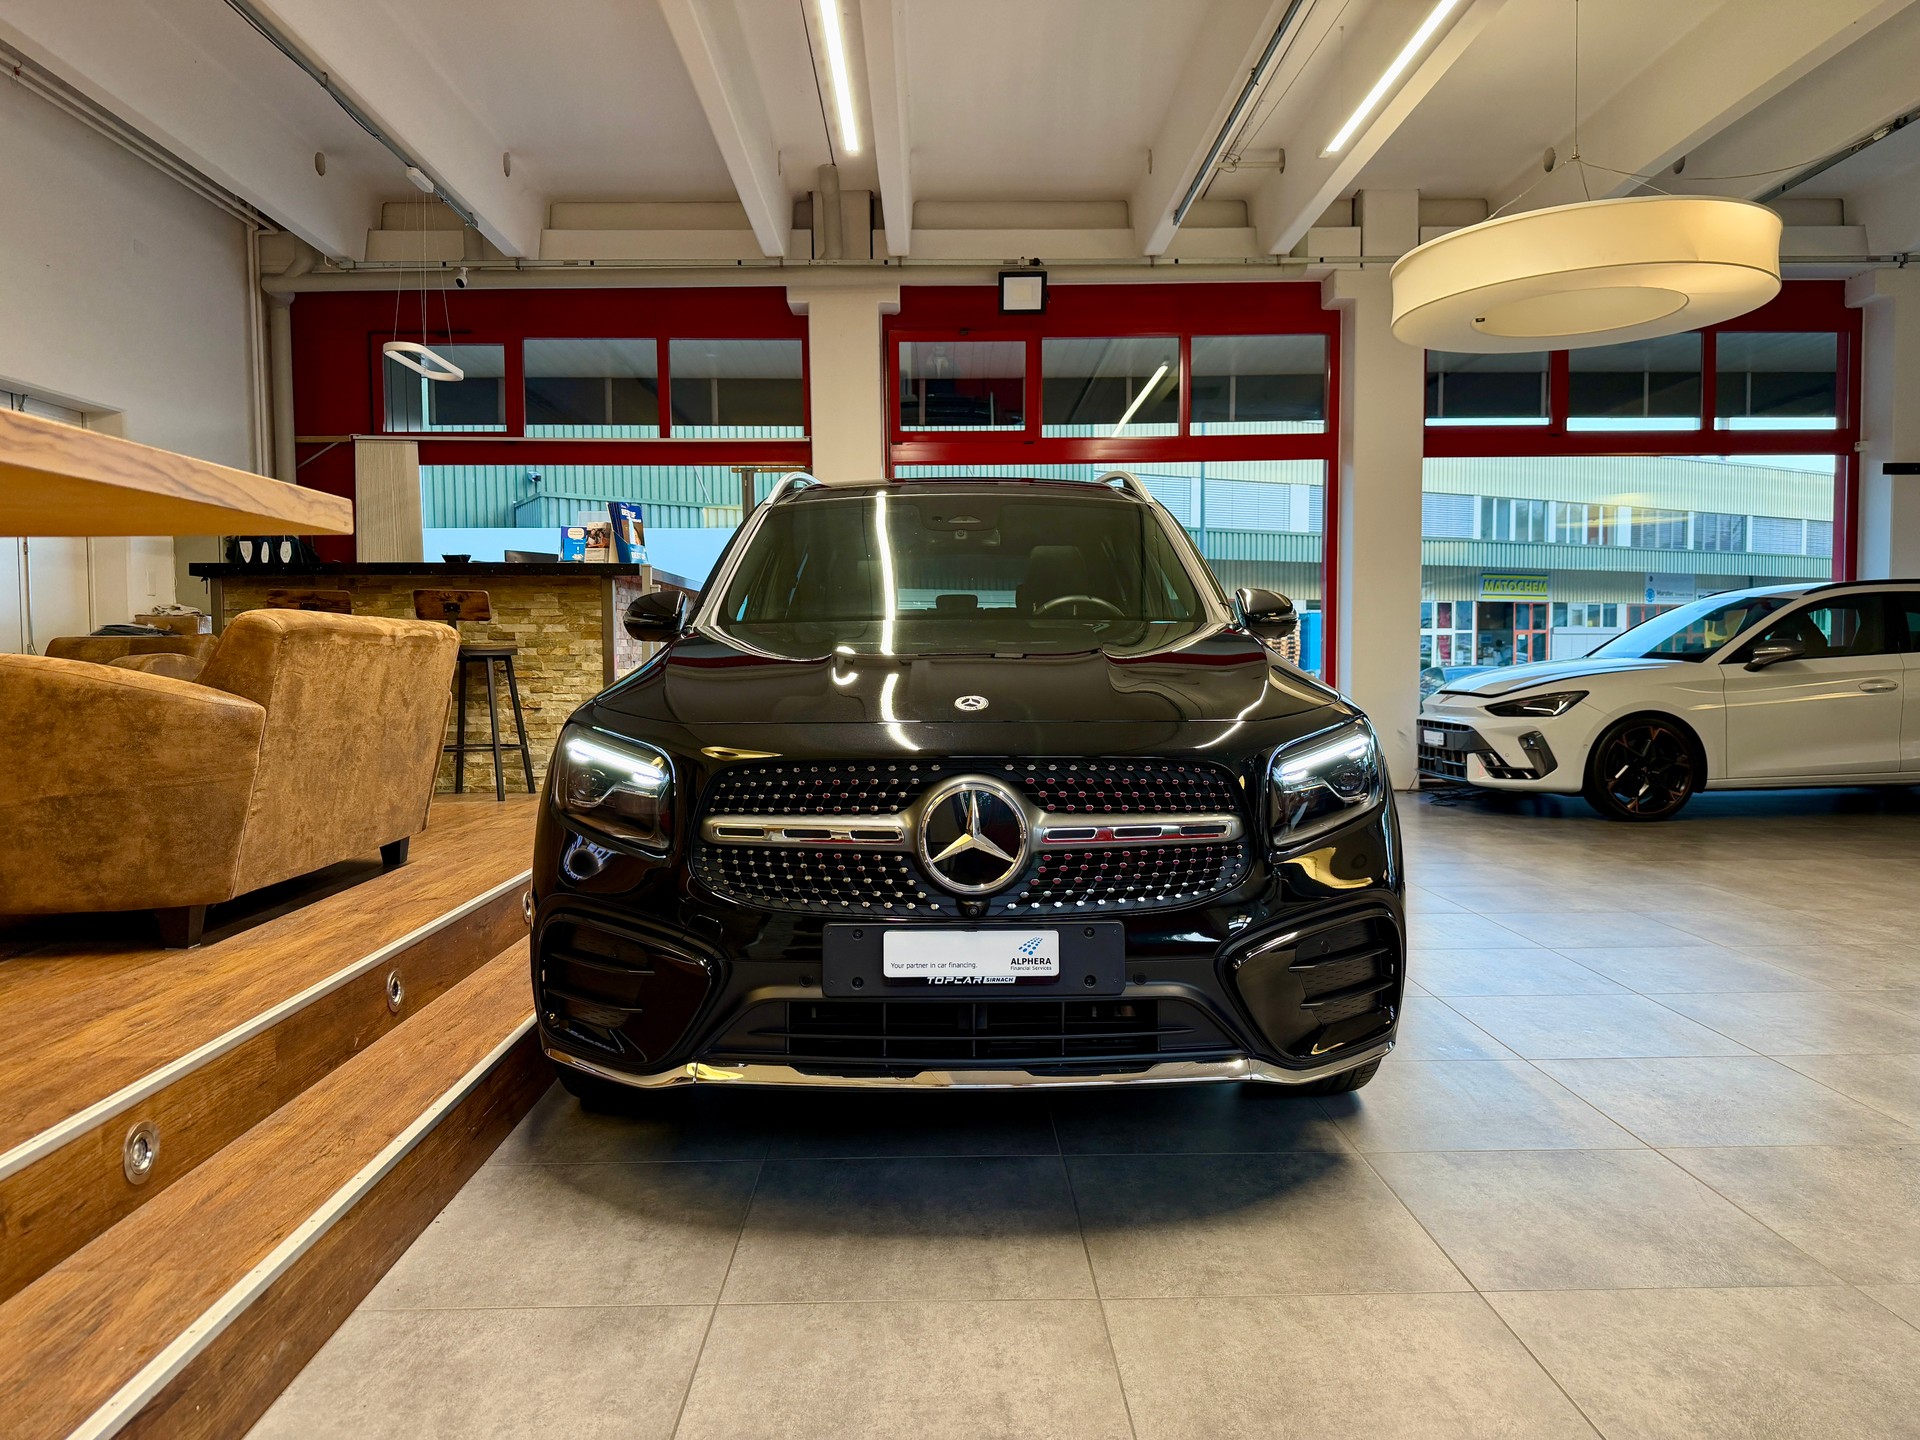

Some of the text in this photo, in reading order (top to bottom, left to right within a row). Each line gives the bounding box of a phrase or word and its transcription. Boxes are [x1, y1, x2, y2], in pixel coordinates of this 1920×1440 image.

[1483, 580, 1547, 592] MATOCHEM
[1010, 957, 1052, 965] ALPHERA
[906, 962, 928, 970] partner
[948, 961, 978, 970] financing.
[926, 976, 982, 984] TOPCAR
